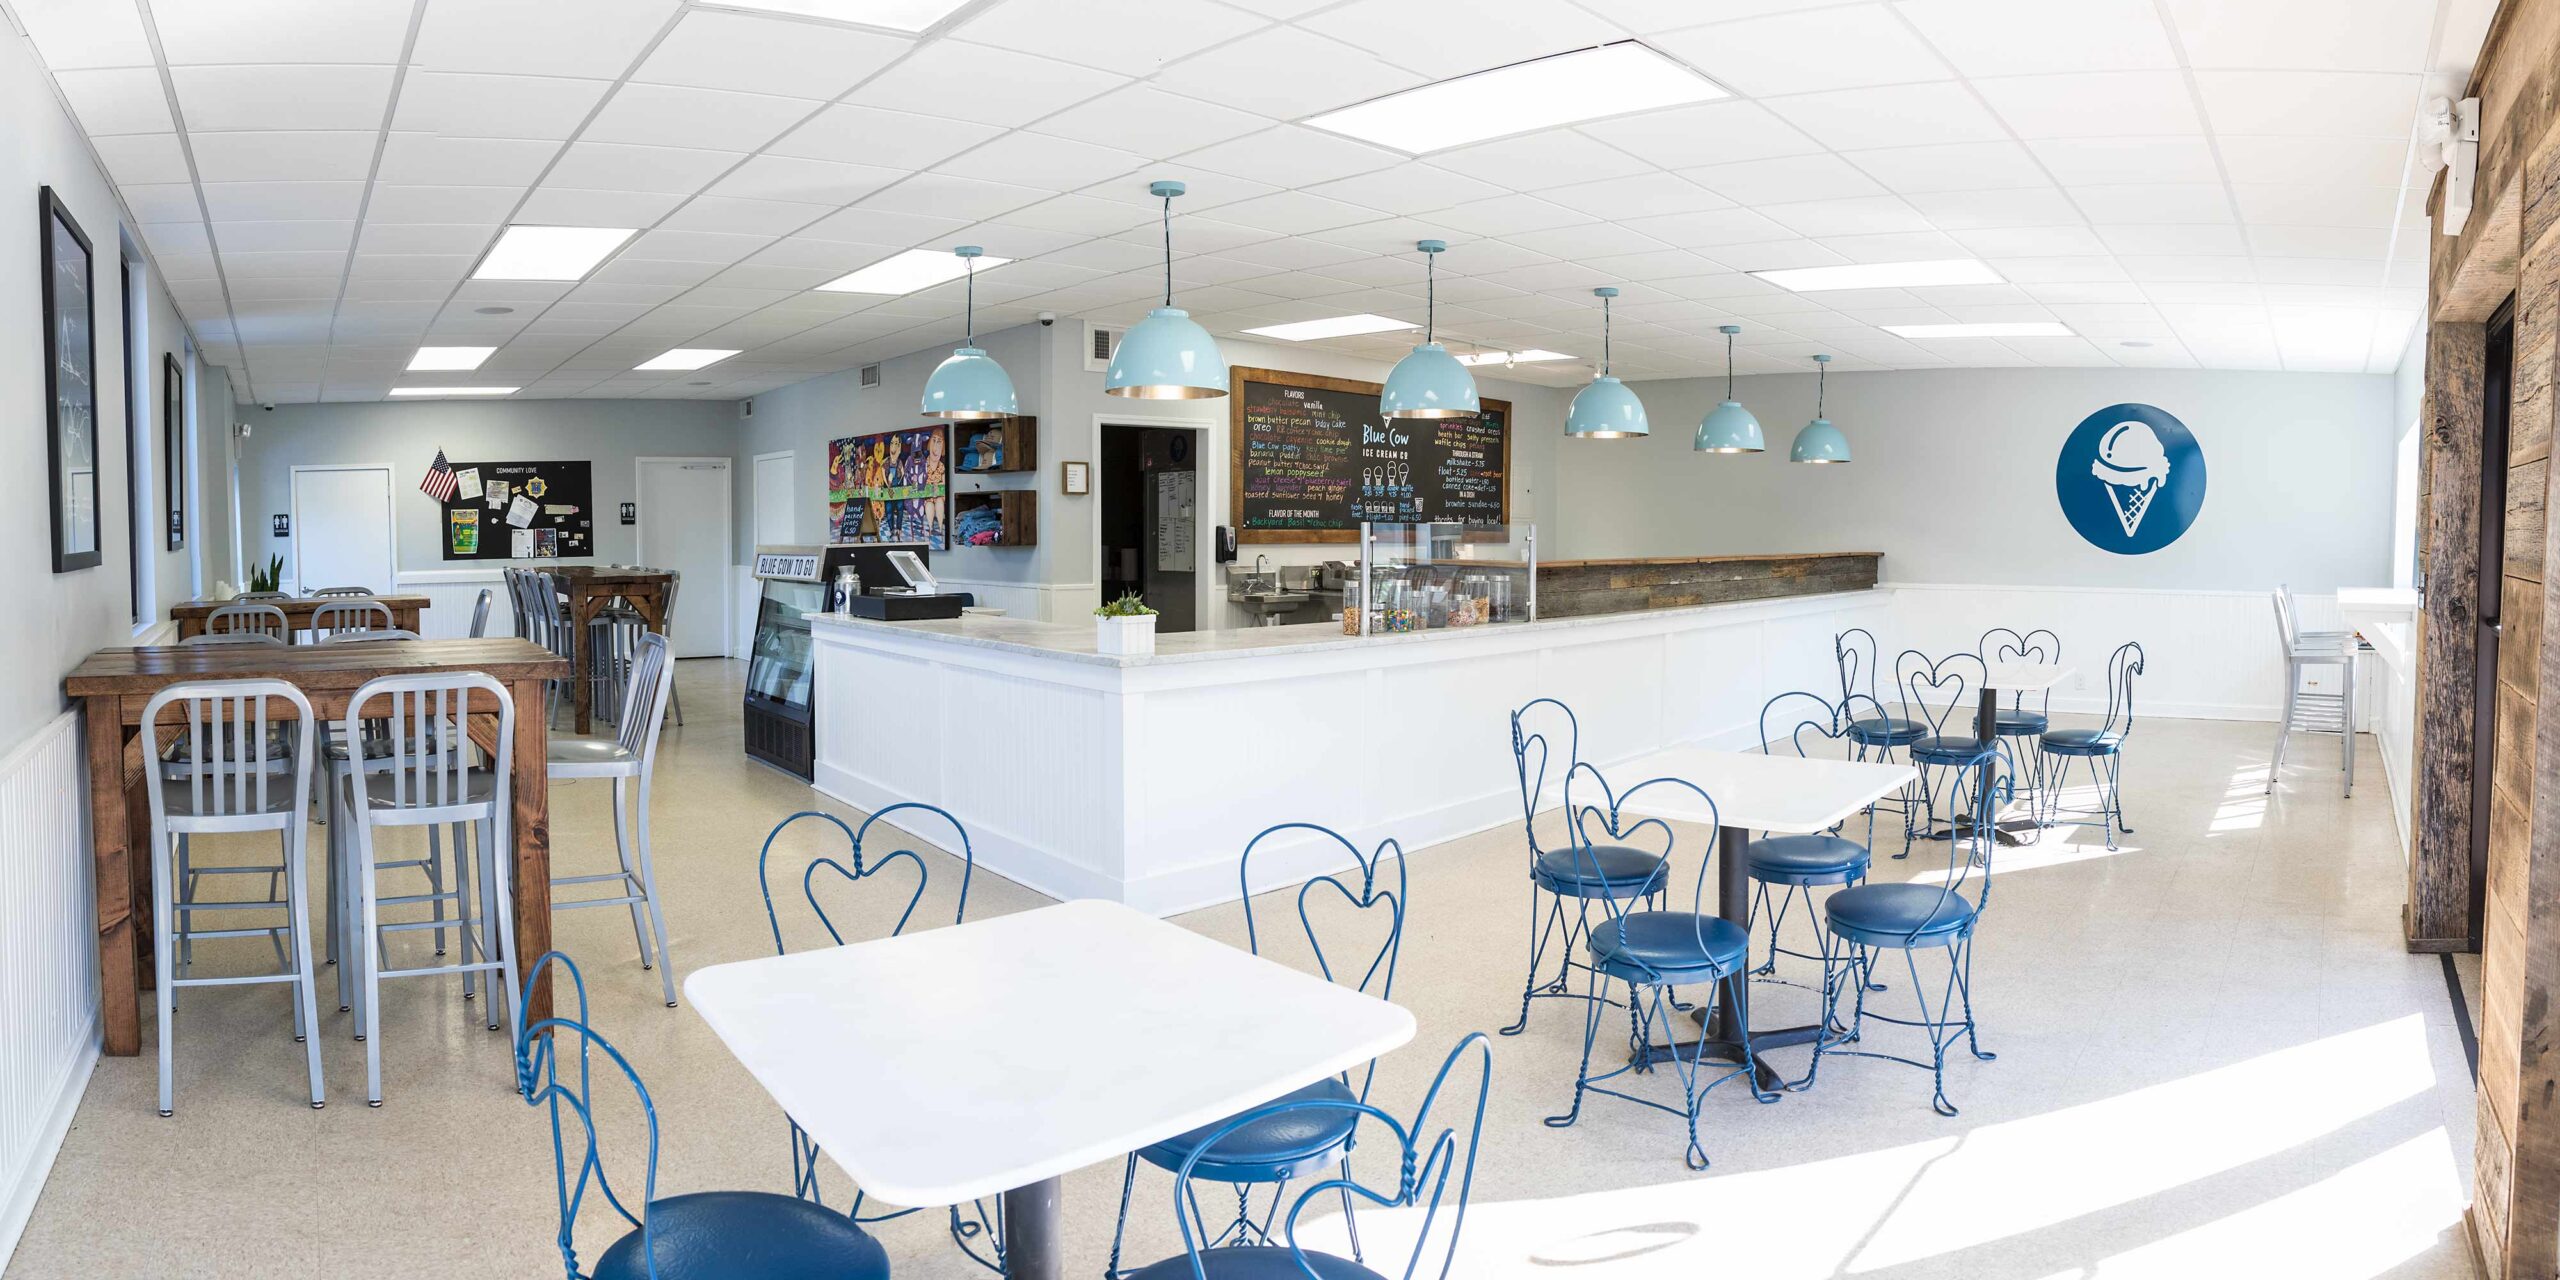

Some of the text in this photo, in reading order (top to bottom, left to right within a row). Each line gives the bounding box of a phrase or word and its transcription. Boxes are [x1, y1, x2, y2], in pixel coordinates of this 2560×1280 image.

[1284, 389, 1305, 400] FLAVORS
[1303, 400, 1323, 410] vanilla
[1247, 415, 1266, 424] brown
[1267, 416, 1288, 425] butter
[1290, 418, 1311, 427] pecan
[1331, 420, 1346, 428] cake
[1253, 423, 1271, 432] oreo
[1466, 425, 1486, 434] crushed
[1362, 423, 1409, 448] Blue Cow
[1252, 440, 1265, 449] Blue
[1267, 442, 1279, 450] Cow
[1282, 444, 1300, 454] patty
[1316, 438, 1335, 447] cookie
[1336, 438, 1352, 449] dough
[1434, 437, 1452, 447] waffle
[1250, 448, 1274, 457] banana
[1362, 448, 1374, 458] ICE
[1376, 449, 1398, 459] CREAM
[1248, 459, 1271, 468] peanut
[1273, 460, 1293, 468] butter
[1265, 466, 1284, 475] lemon
[1307, 484, 1326, 493] peach
[1245, 490, 1269, 499] toasted
[1271, 490, 1300, 500] sunflower
[1302, 491, 1316, 500] seed
[1325, 493, 1344, 504] honey
[1268, 509, 1320, 518] FLAVOR OF THE MONTH
[1468, 514, 1484, 528] buying
[760, 558, 815, 577] BLUE COW TO GO
